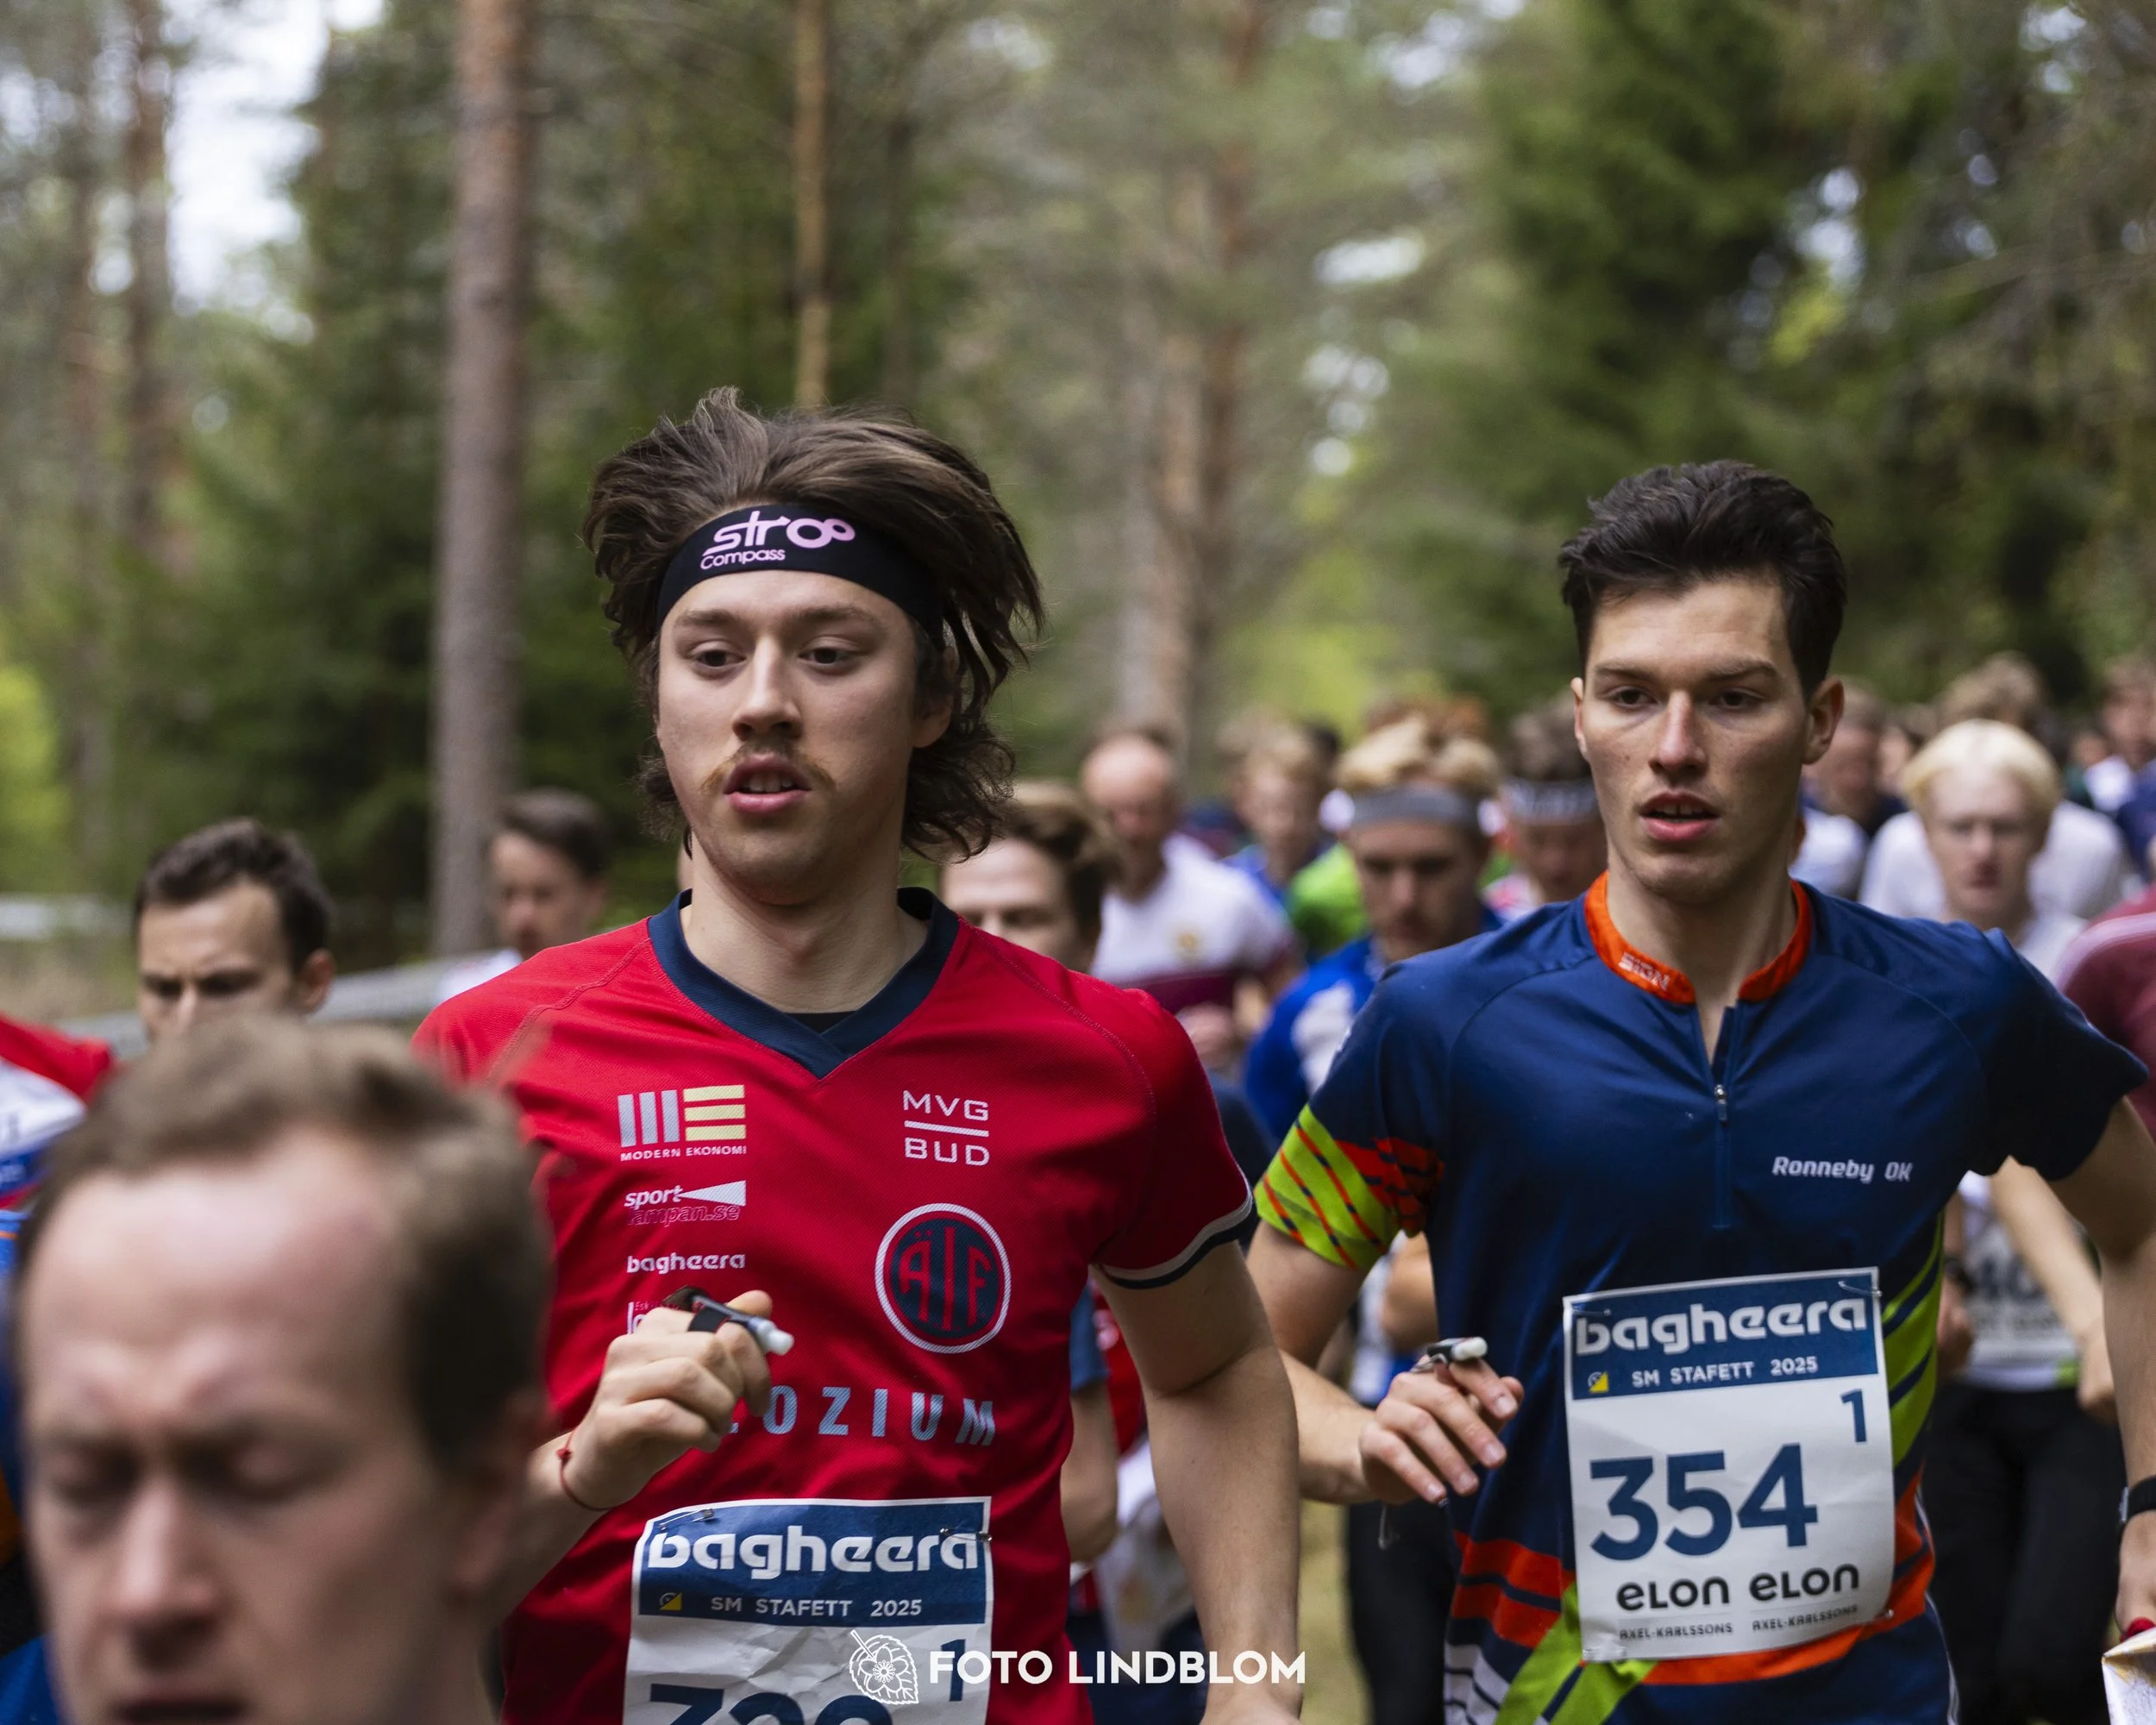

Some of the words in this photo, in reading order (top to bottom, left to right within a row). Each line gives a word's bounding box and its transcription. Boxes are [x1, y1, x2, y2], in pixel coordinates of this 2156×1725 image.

[699, 549, 786, 570] Compass
[903, 1090, 989, 1121] MVG
[620, 1148, 681, 1162] MODERN
[686, 1145, 747, 1157] EKONOMI
[905, 1137, 990, 1166] BUD
[1772, 1156, 1875, 1182] Ronneby
[1884, 1162, 1914, 1182] OK
[624, 1184, 683, 1210] sport
[626, 1252, 746, 1275] bagheera
[1576, 1298, 1866, 1356] bagheera
[1632, 1370, 1660, 1389] SM
[1670, 1361, 1754, 1384] STAFETT
[1771, 1357, 1818, 1377] 2025
[1840, 1389, 1868, 1443] 1
[1590, 1442, 1818, 1560] 354
[648, 1525, 978, 1580] bagheera
[711, 1596, 742, 1612] SM
[755, 1598, 852, 1617] STAFETT
[870, 1598, 923, 1616] 2025
[1619, 1622, 1733, 1640] AXEL-KARLSSONS
[1752, 1604, 1858, 1632] AXEL-KARLSSONS
[940, 1638, 967, 1703] 1
